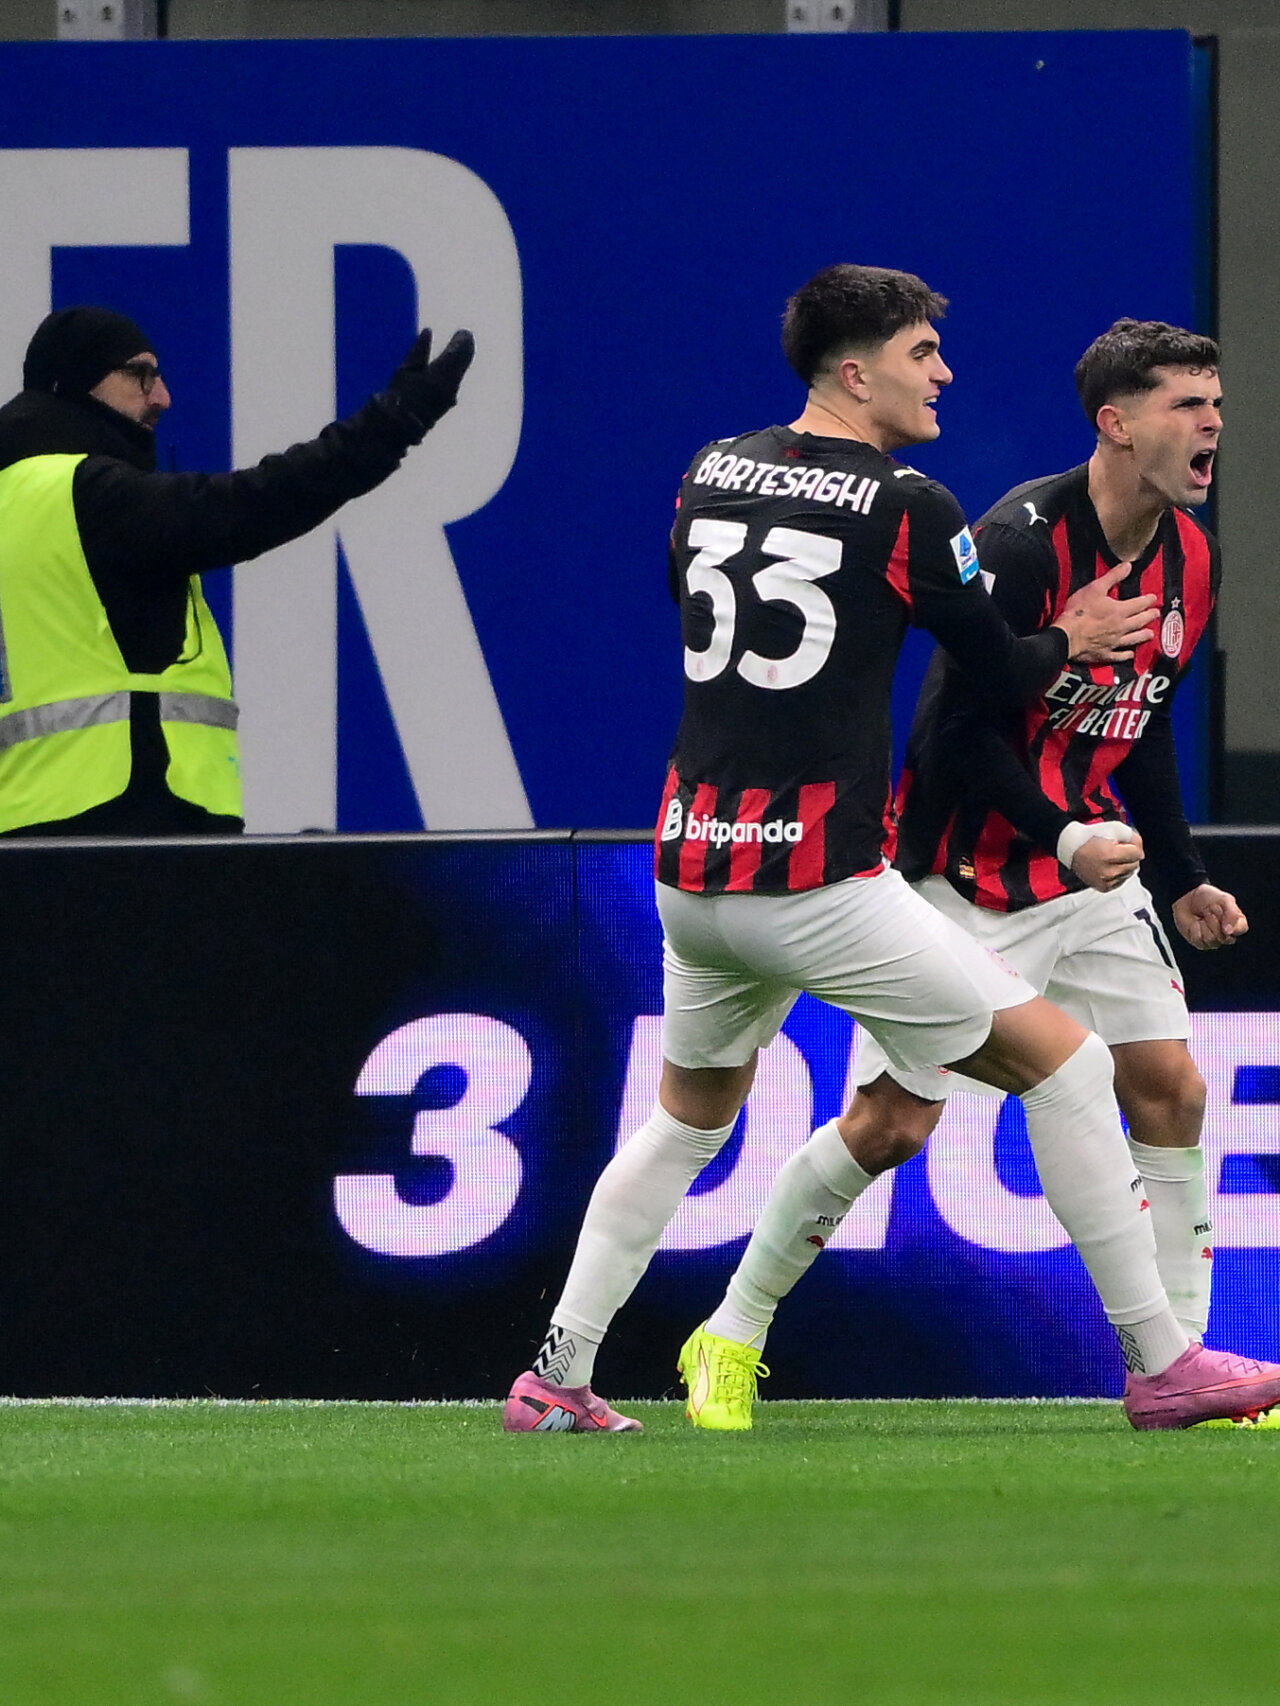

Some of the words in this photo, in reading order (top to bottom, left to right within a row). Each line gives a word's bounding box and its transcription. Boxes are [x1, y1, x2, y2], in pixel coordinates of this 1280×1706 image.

[693, 451, 881, 515] BARTESAGHI
[684, 518, 843, 690] 33
[1076, 708, 1152, 740] BETTER
[685, 811, 804, 849] bitpanda
[333, 1013, 532, 1256] 3
